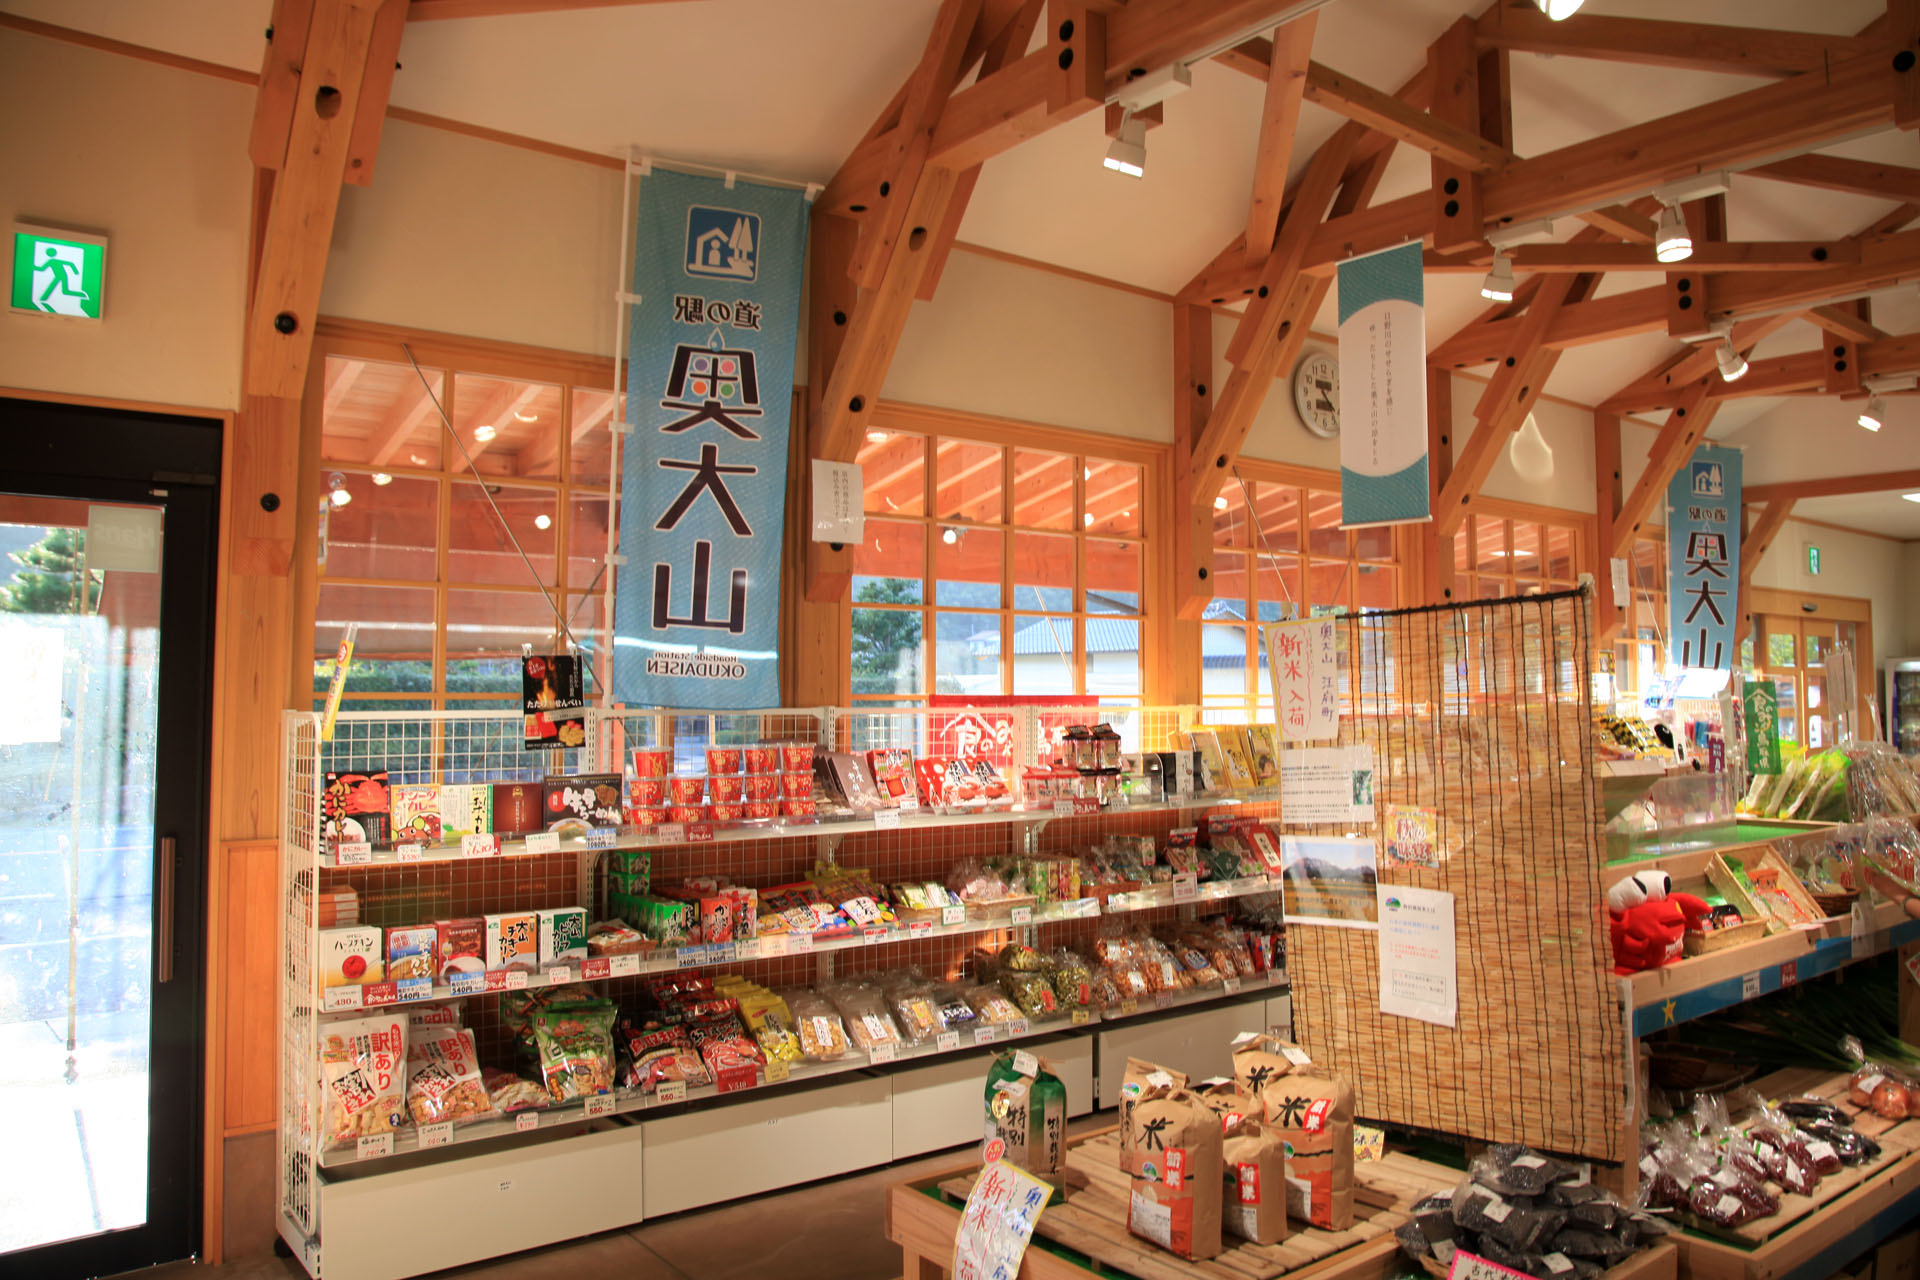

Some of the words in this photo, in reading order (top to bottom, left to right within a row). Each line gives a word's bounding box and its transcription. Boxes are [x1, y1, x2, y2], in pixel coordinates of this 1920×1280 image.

[1278, 632, 1305, 728] 新米入荷
[507, 926, 518, 958] チキン
[516, 920, 529, 942] 大山
[560, 922, 571, 951] ビーフ
[568, 914, 581, 938] 大山
[499, 936, 507, 965] カリー
[552, 930, 560, 959] カリー
[398, 992, 420, 1000] 540円
[452, 986, 473, 994] 540円
[371, 1031, 392, 1090] 訳あり
[438, 1037, 467, 1077] 訳あり
[1246, 1064, 1275, 1093] 米
[1007, 1105, 1027, 1147] 特別
[1271, 1096, 1312, 1128] 米
[1137, 1117, 1174, 1151] 米
[1166, 1150, 1182, 1188] 新米
[1240, 1165, 1256, 1201] 新米
